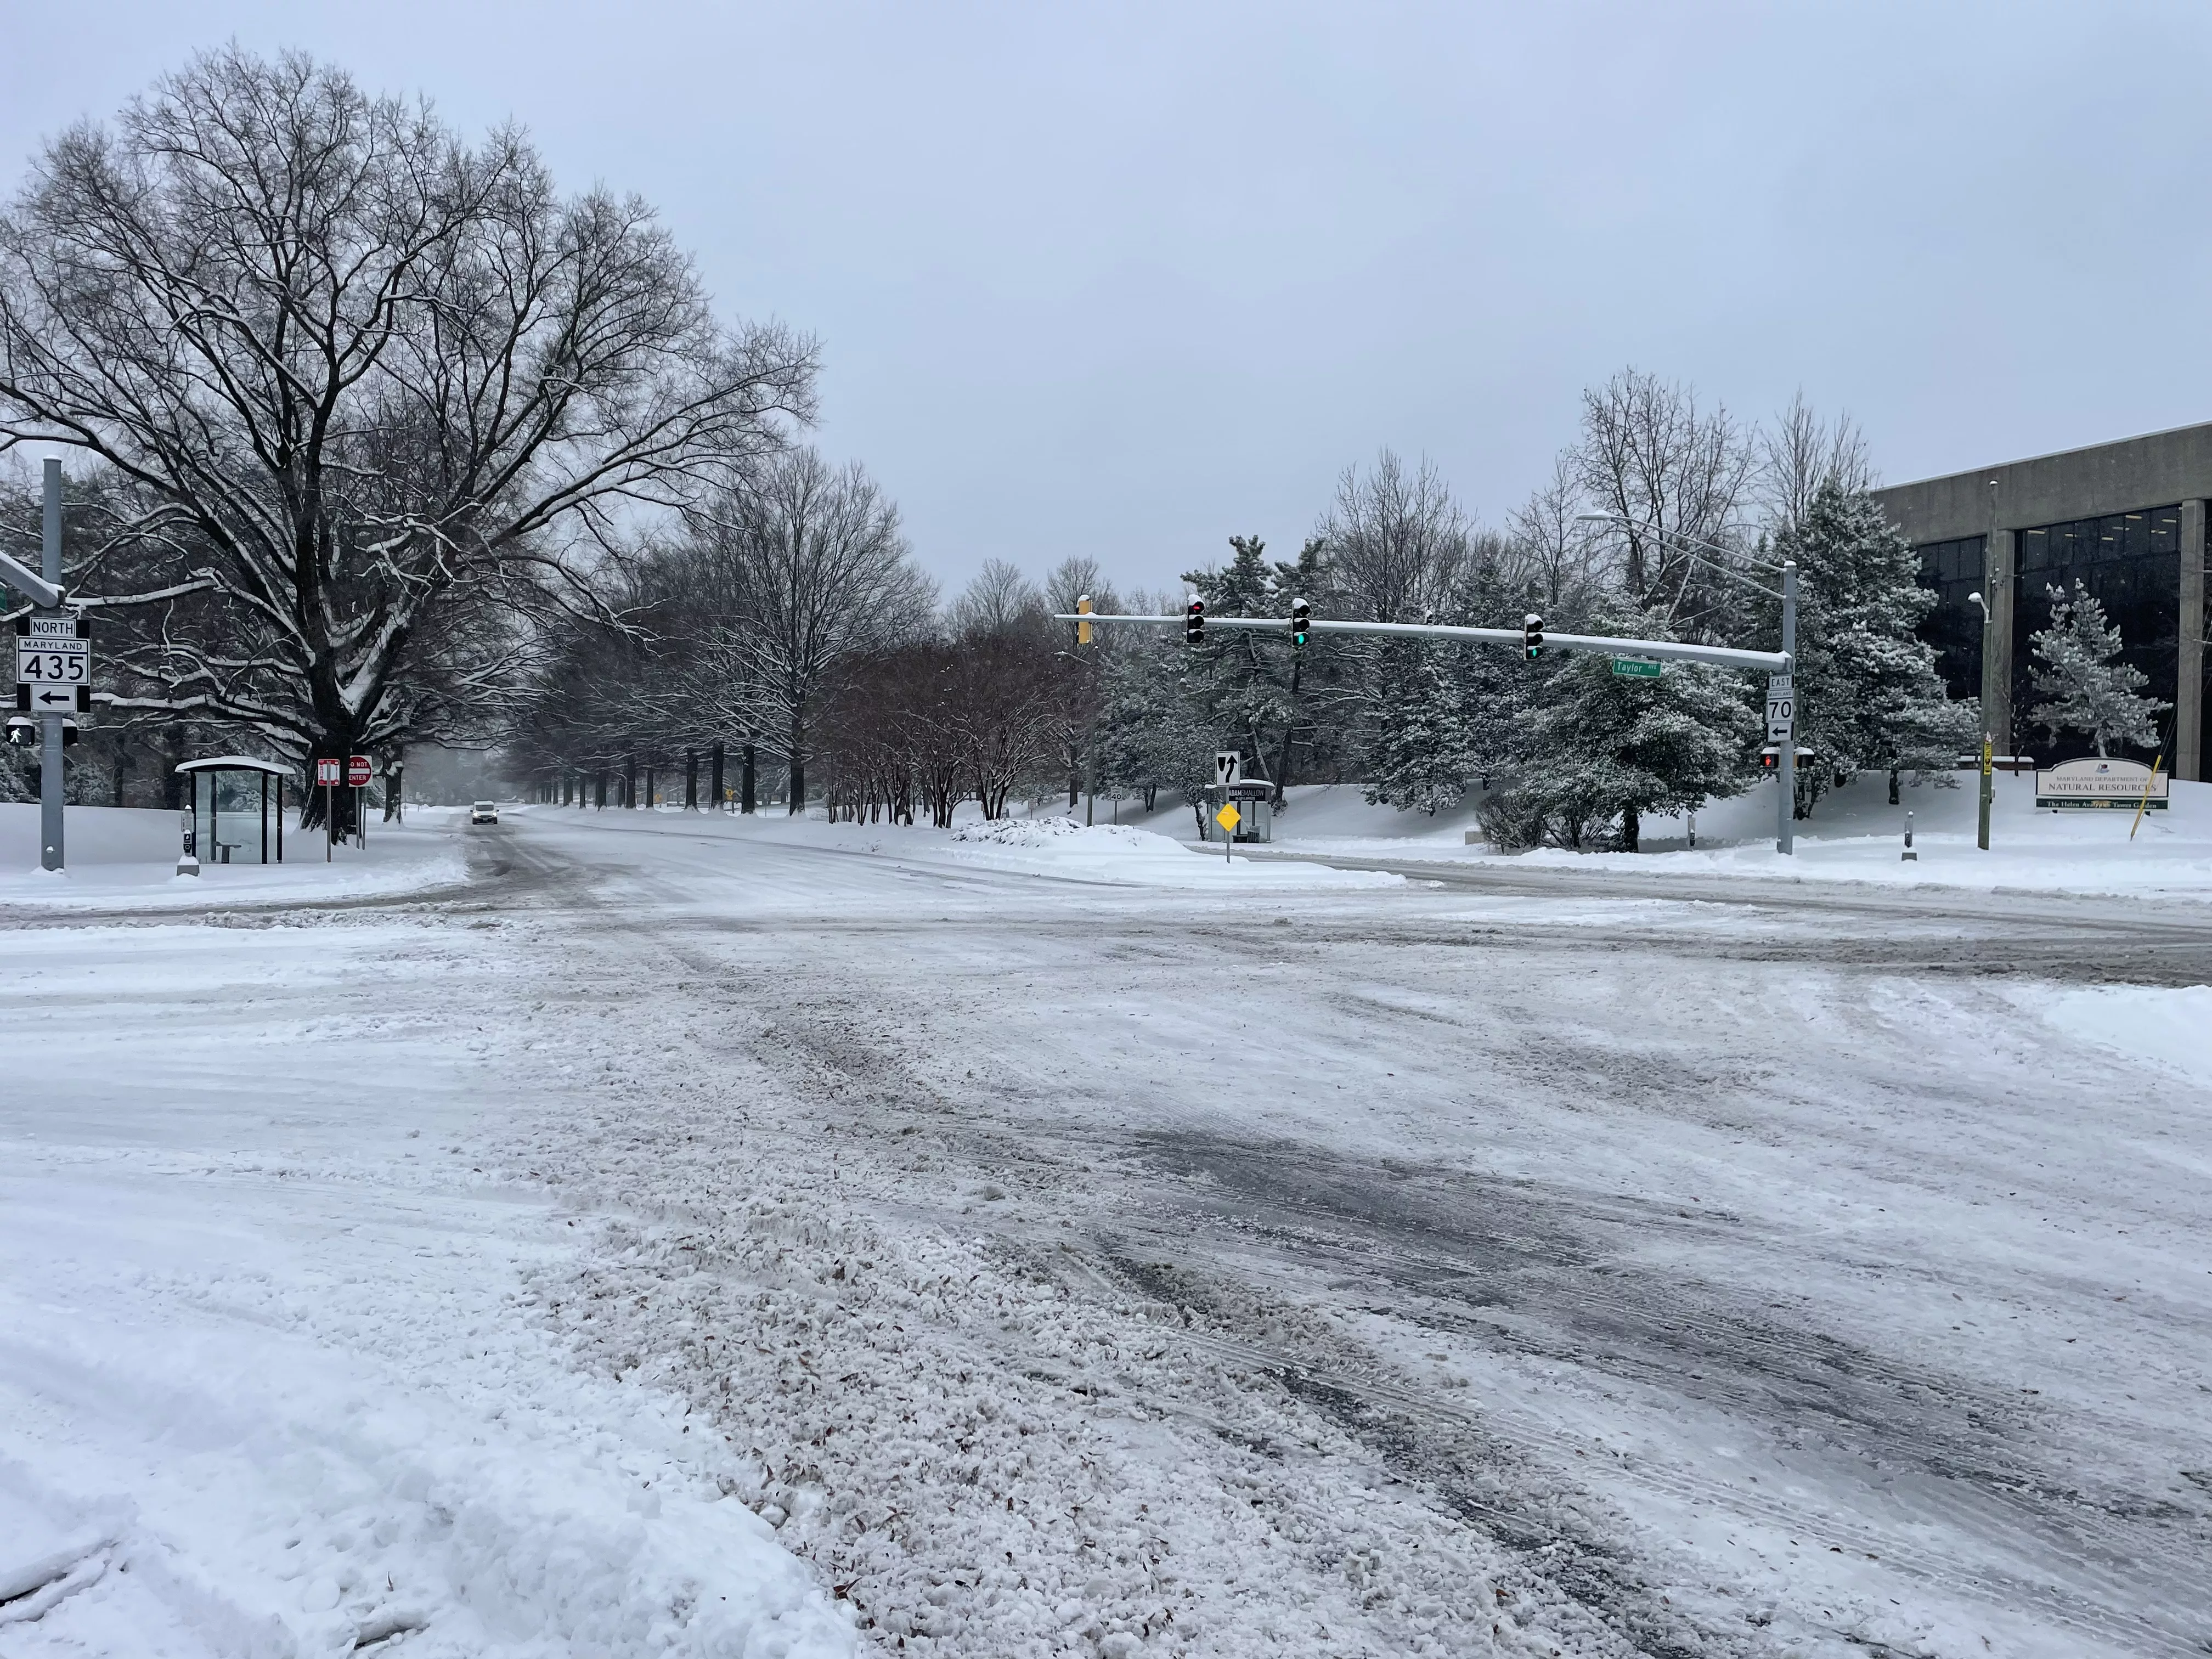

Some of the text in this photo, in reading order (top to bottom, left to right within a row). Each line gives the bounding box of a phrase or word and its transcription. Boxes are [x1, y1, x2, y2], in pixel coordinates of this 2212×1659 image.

[33, 621, 73, 634] NORTH
[24, 640, 82, 650] MARYLAND
[24, 655, 84, 680] 435
[1617, 661, 1643, 674] Taylor
[1771, 677, 1790, 687] EAST
[1769, 701, 1791, 719] 70
[2049, 783, 2095, 791] NATURAL
